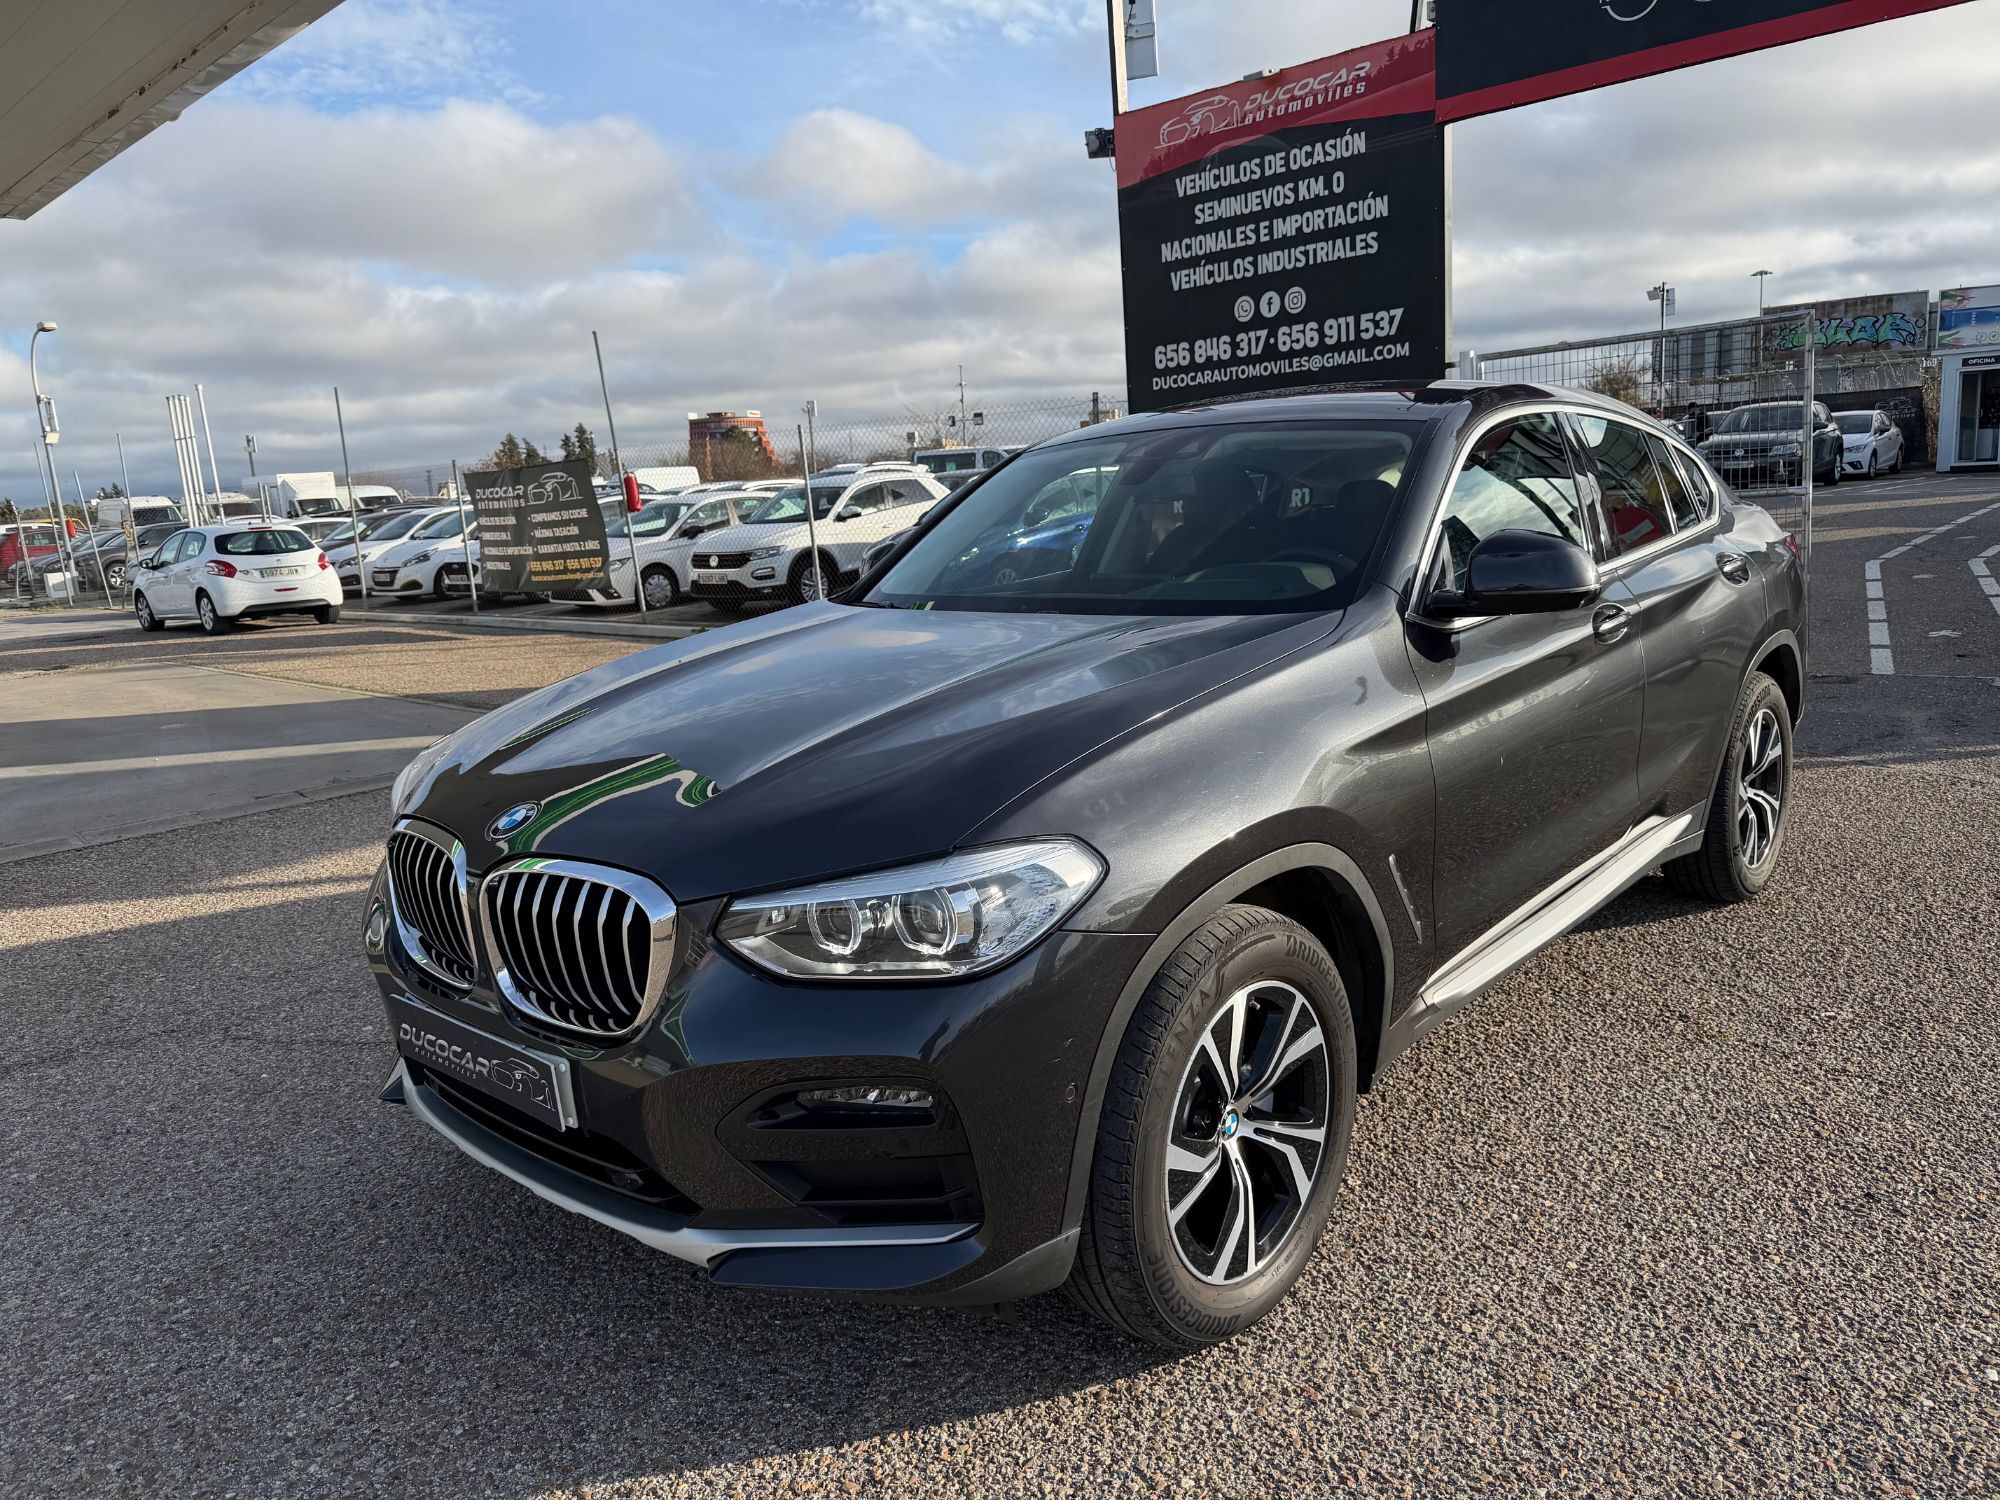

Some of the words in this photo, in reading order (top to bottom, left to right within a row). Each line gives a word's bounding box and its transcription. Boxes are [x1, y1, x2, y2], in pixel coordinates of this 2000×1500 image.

[1244, 61, 1371, 110] DUCOCAR
[1244, 82, 1366, 125] automóviles
[1175, 158, 1261, 198] VEHÍCULOS
[1264, 152, 1286, 177] DE
[1289, 128, 1366, 171] OCASIÓN
[1194, 183, 1295, 225] SEMINUEVOS
[1298, 175, 1329, 202] KM.
[1161, 224, 1257, 263] NACIONALES
[1259, 221, 1270, 243] E
[1272, 191, 1389, 240] IMPORTACIÓN
[1170, 256, 1254, 292] VEHÍCULOS
[1257, 231, 1379, 275] INDUSTRIALES
[1154, 342, 1190, 370] 656
[1194, 335, 1232, 364] 846
[1323, 315, 1355, 345] 911
[1360, 307, 1404, 340] 537
[1968, 357, 1996, 365] OFICINA
[1152, 342, 1410, 391] DUCOCARAUTOMOVILES@GMAIL.COM
[475, 485, 525, 499] DUCOCAR
[569, 508, 589, 519] COCHE
[580, 541, 586, 550] 2
[1285, 933, 1353, 1037] BRIDGESTONE
[400, 1022, 490, 1078] DUCOCAR
[1146, 1250, 1242, 1337] BRIDGESTONE
